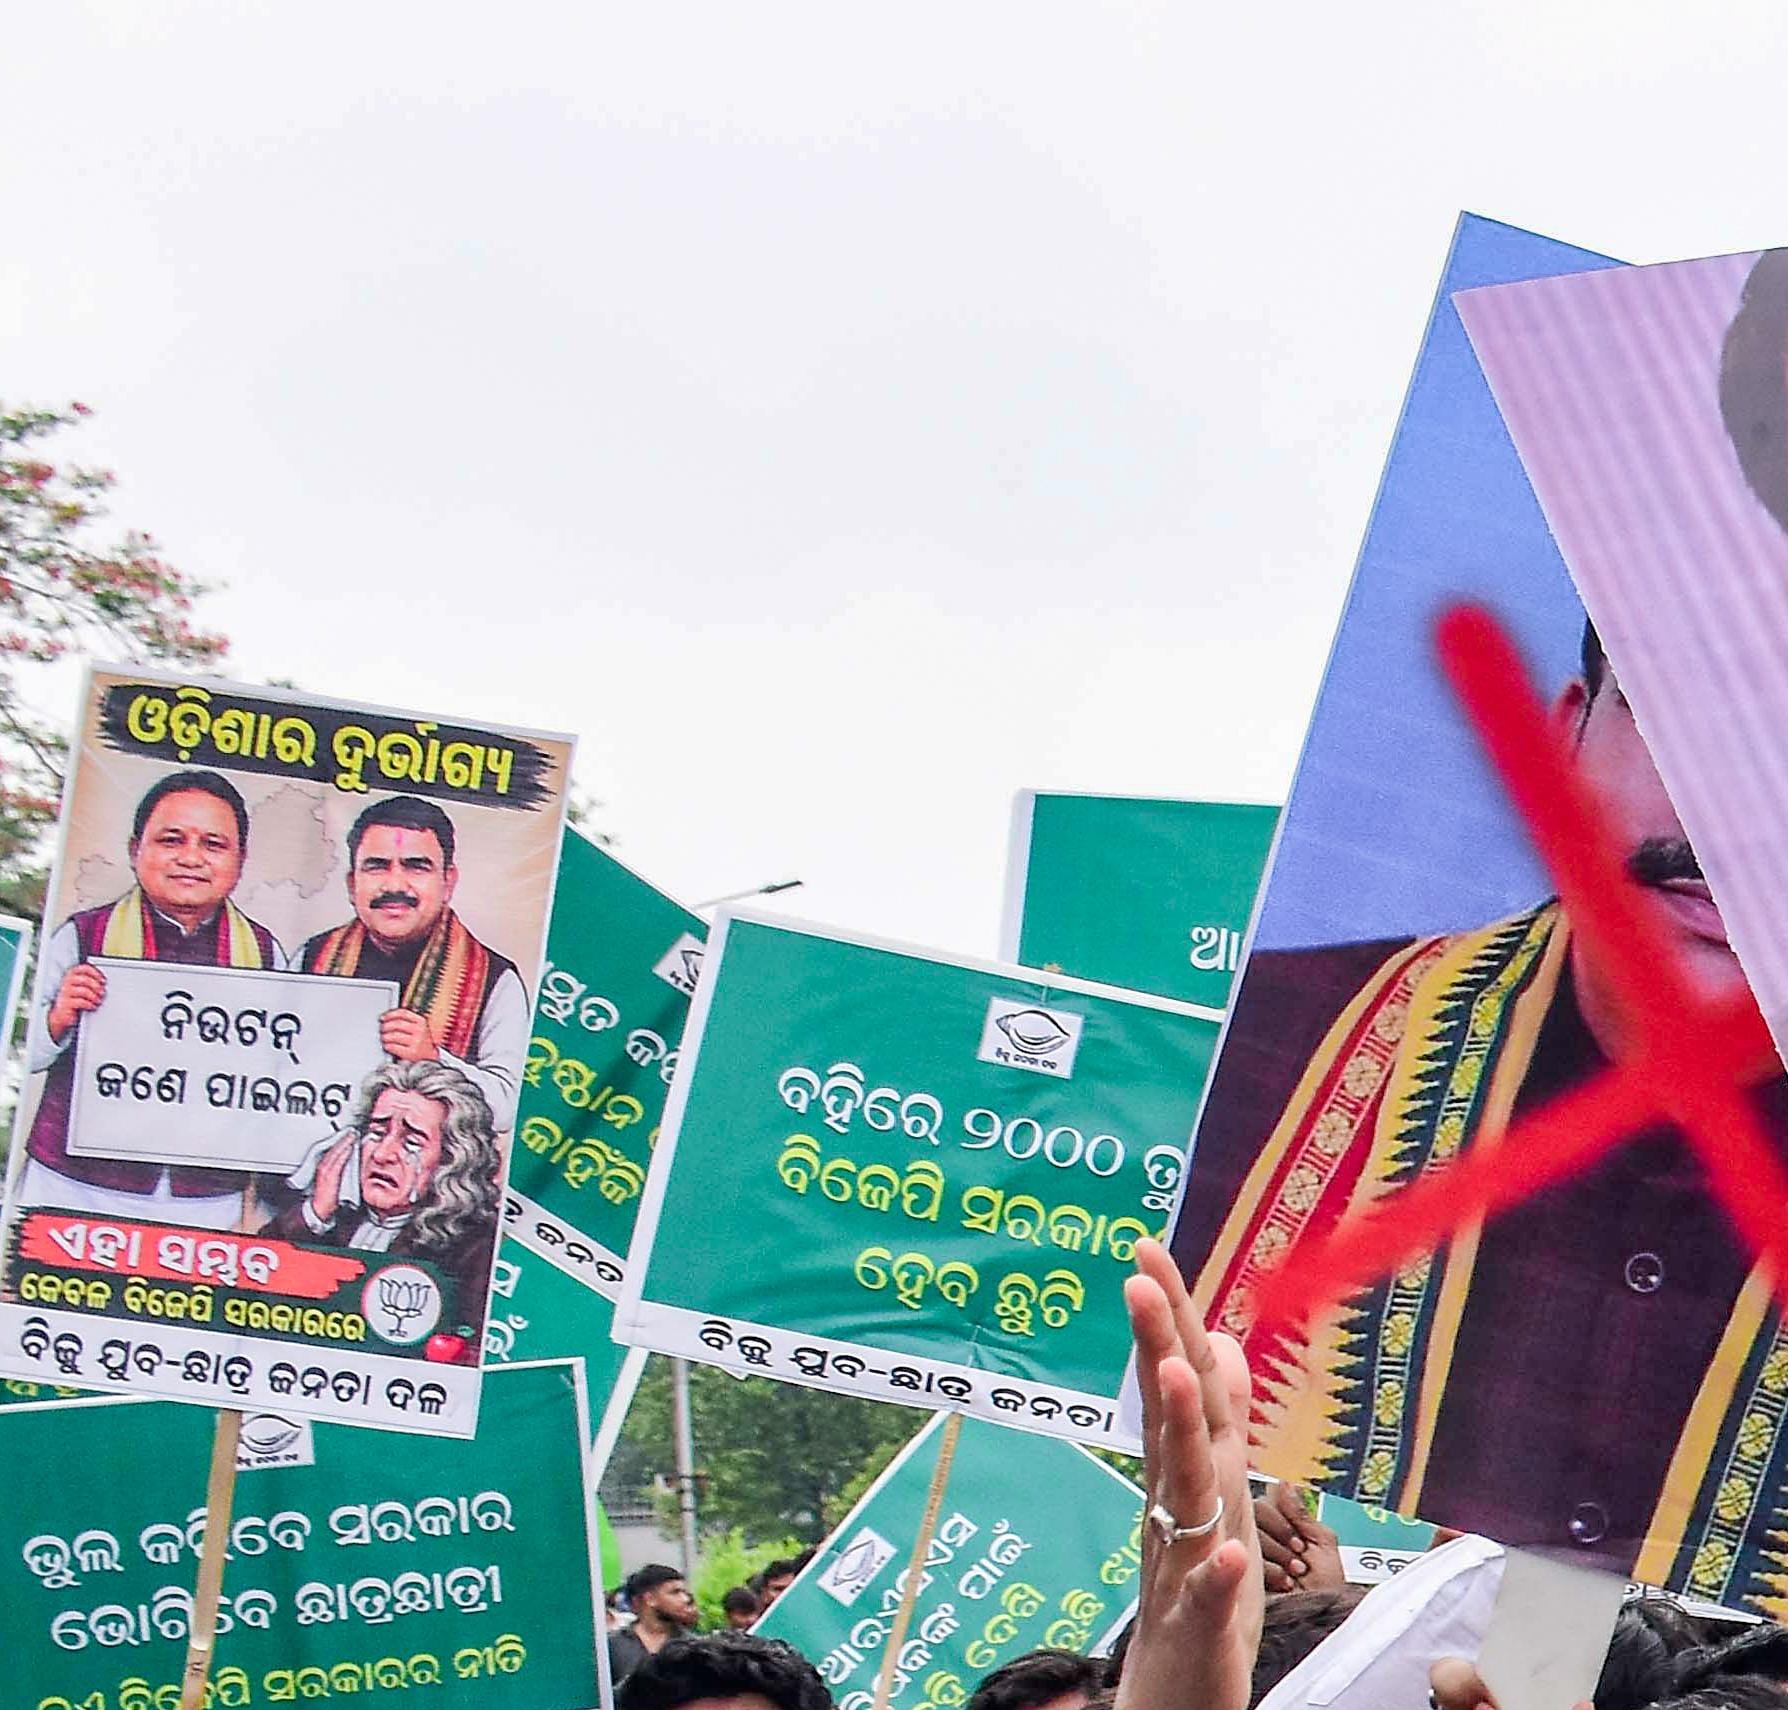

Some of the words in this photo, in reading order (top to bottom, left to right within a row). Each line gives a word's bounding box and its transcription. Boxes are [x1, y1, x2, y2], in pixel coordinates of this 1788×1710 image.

[128, 687, 314, 768] ଓଡ଼ିଶାର
[333, 720, 514, 795] ଦୁର୍ଭାଗ୍ୟ
[161, 992, 302, 1064] ନିଉଟନ୍
[97, 1059, 187, 1105] ଜଣେ
[206, 1070, 350, 1131] ପାଇଲଟ୍
[778, 1062, 945, 1141] ବହିରେ
[961, 1108, 1125, 1178] ୨୦୦୦
[776, 1134, 945, 1222] ବିଜେପି
[49, 1220, 143, 1269] ଏହା
[156, 1236, 280, 1289] ସମ୍ଭବ
[855, 1247, 980, 1310] ହେବ
[995, 1268, 1085, 1337] ଛୁଟି
[20, 1272, 112, 1308] କେବଳ
[125, 1275, 214, 1323] ବିଜେପି
[223, 1301, 366, 1343] ସରକାରରେ
[21, 1316, 83, 1375] ବିଜୁ
[268, 1361, 370, 1408] ଜନତା
[386, 1379, 448, 1416] ଦଳ
[700, 1317, 772, 1366] ବିଜୁ
[990, 1386, 1116, 1433] ଜନତା
[23, 1530, 123, 1588] ଭୁଲ
[329, 1491, 516, 1546] ସରକାର
[295, 1565, 502, 1626] ଛାତ୍ରଛାତ୍ରୀ
[264, 1653, 441, 1702] ସରକାରର
[453, 1634, 527, 1679] ନୀତି
